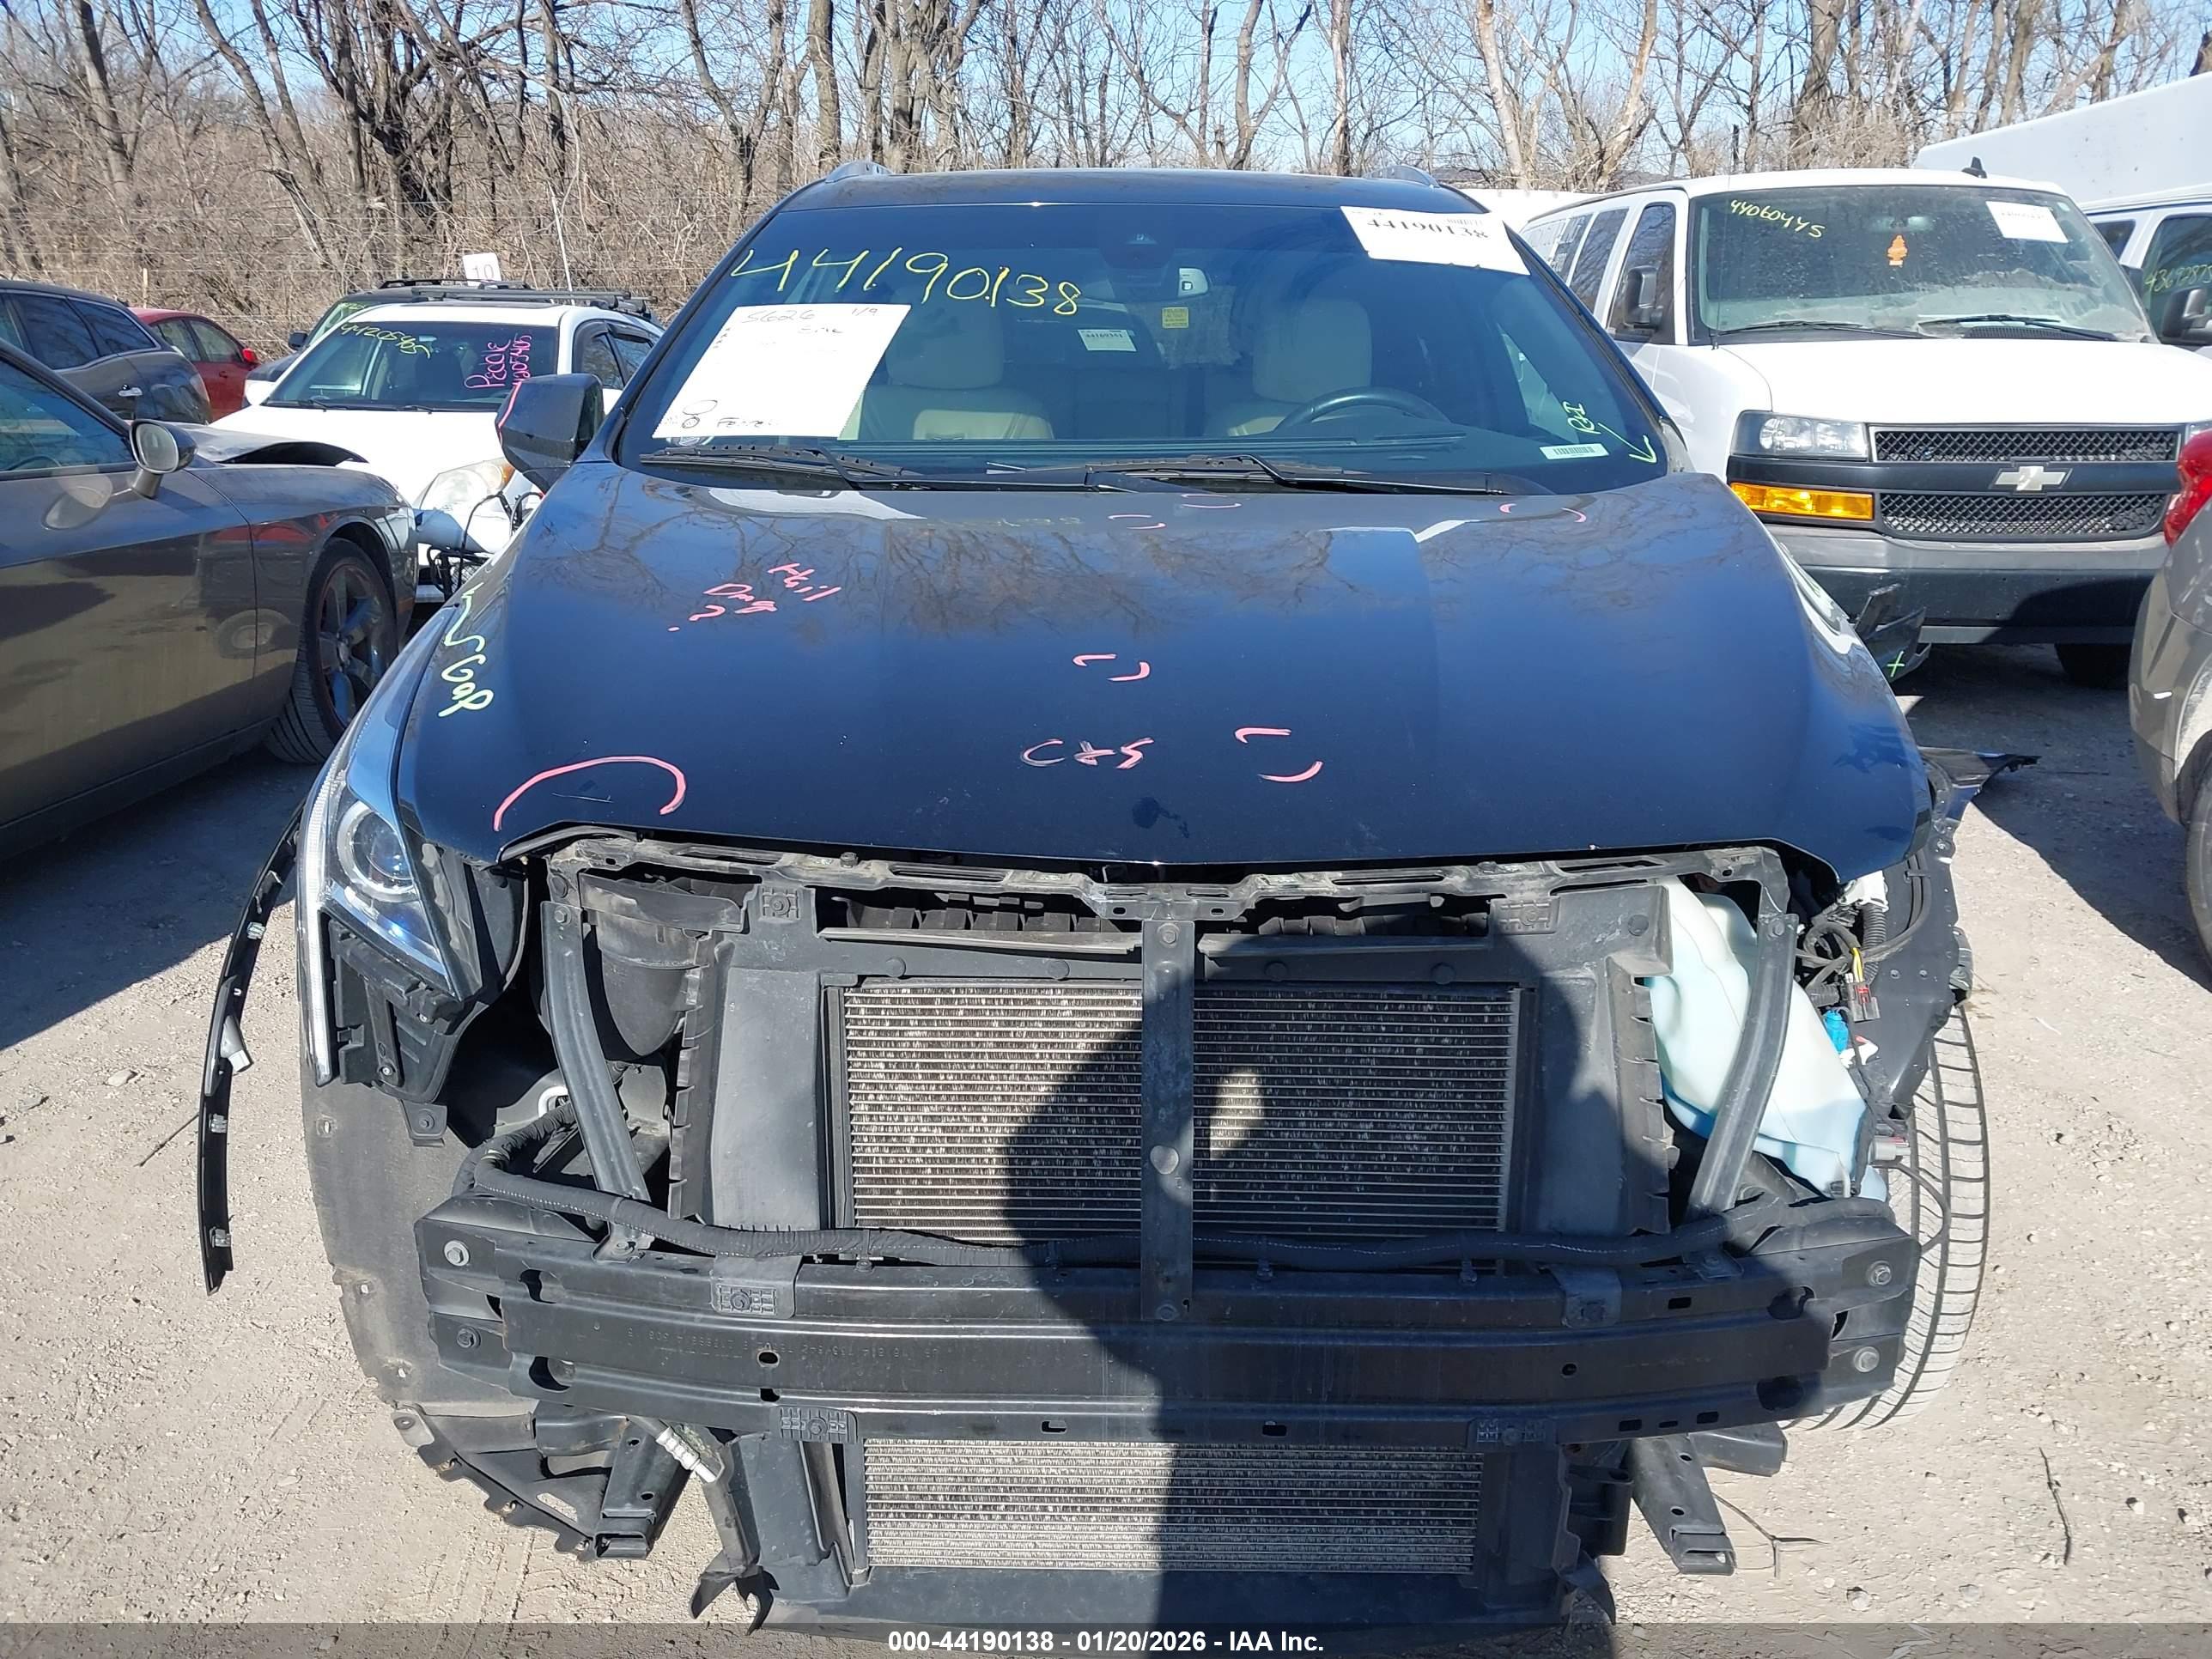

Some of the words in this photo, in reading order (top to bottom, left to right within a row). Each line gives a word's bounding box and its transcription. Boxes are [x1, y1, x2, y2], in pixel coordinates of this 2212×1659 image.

[1367, 218, 1488, 239] 44190138
[1730, 199, 1826, 238] 44060445
[731, 247, 1082, 315] 44190138
